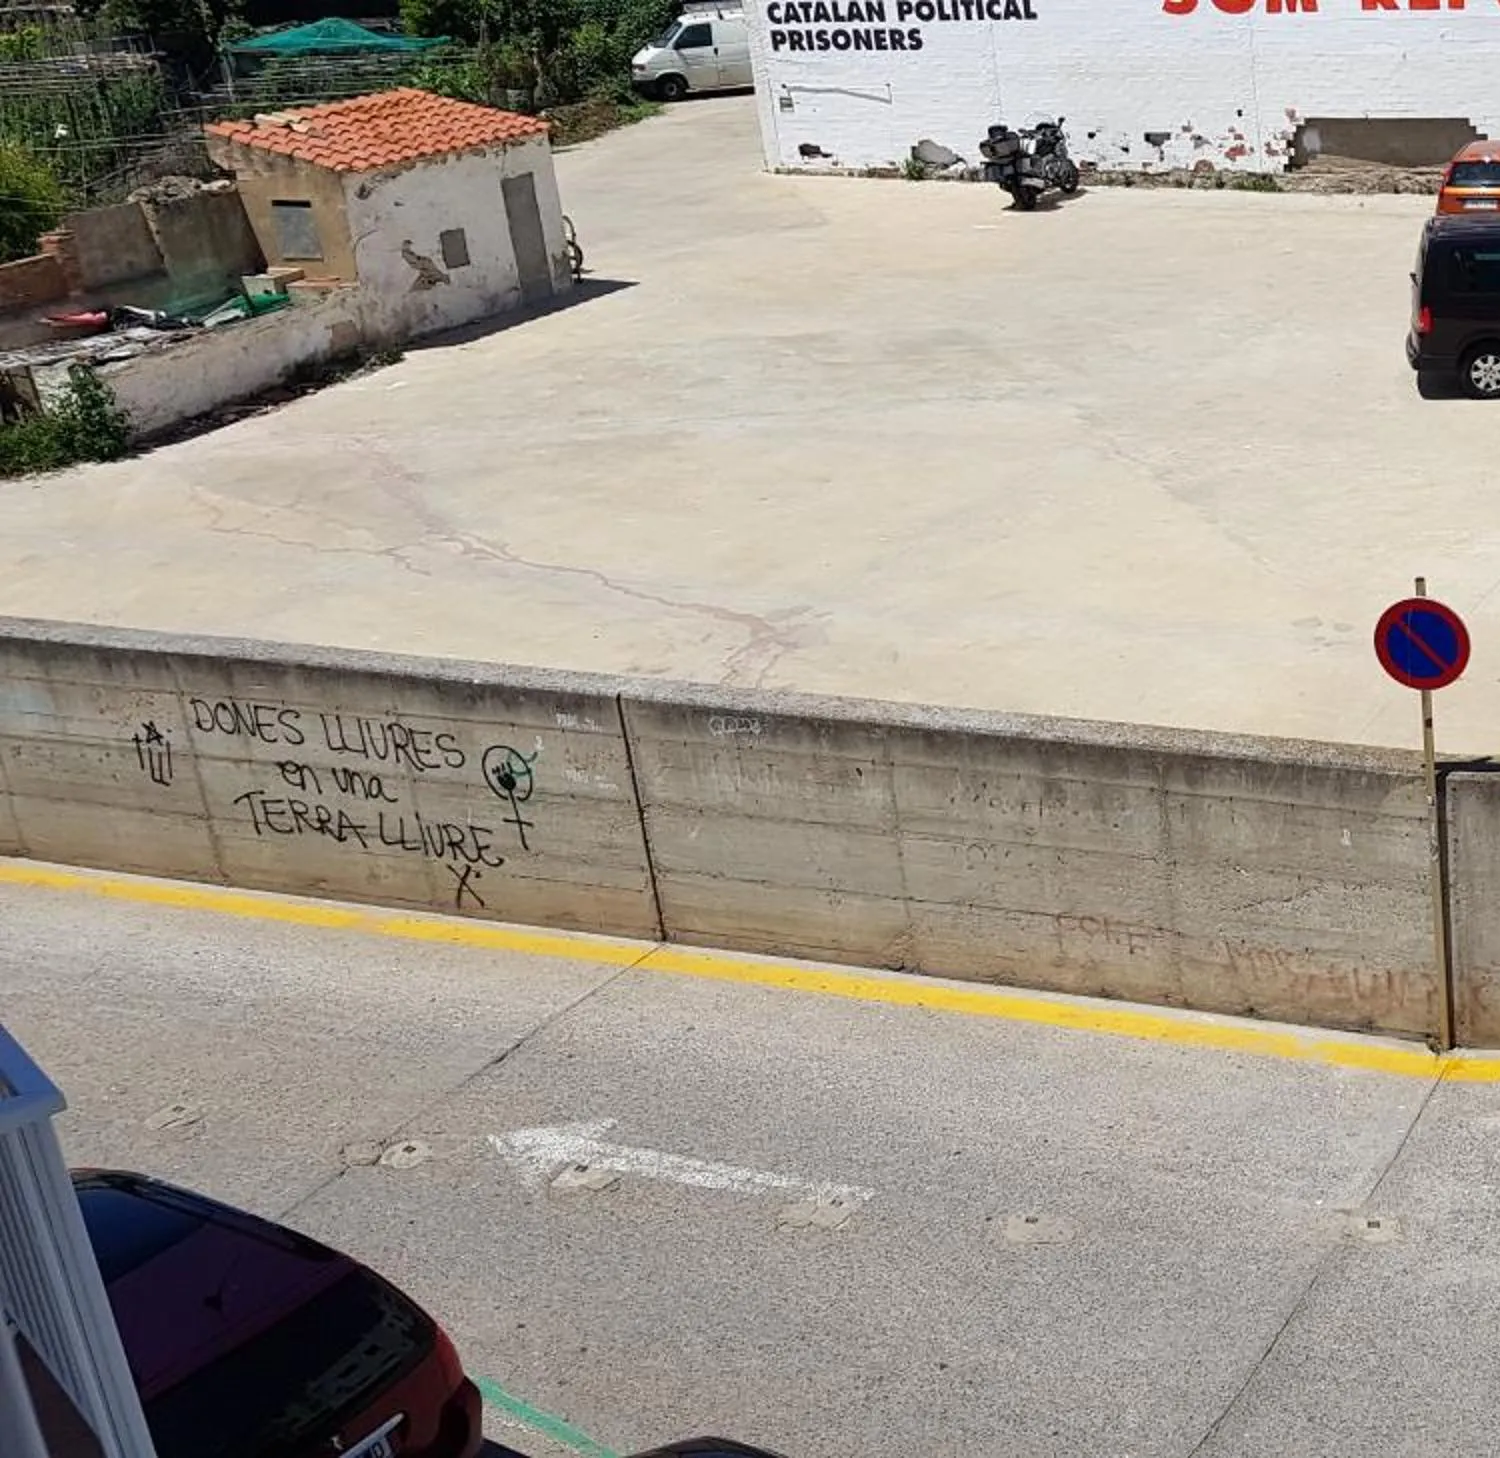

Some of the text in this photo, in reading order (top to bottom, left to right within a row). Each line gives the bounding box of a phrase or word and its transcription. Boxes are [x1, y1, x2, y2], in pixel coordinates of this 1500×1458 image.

[767, 0, 1038, 24] CATALAN POLITICAL
[770, 29, 924, 51] PRISONERS
[190, 697, 466, 772] DONES LLIURES
[276, 760, 399, 803] en una
[233, 790, 505, 868] TERRA LLIURE
